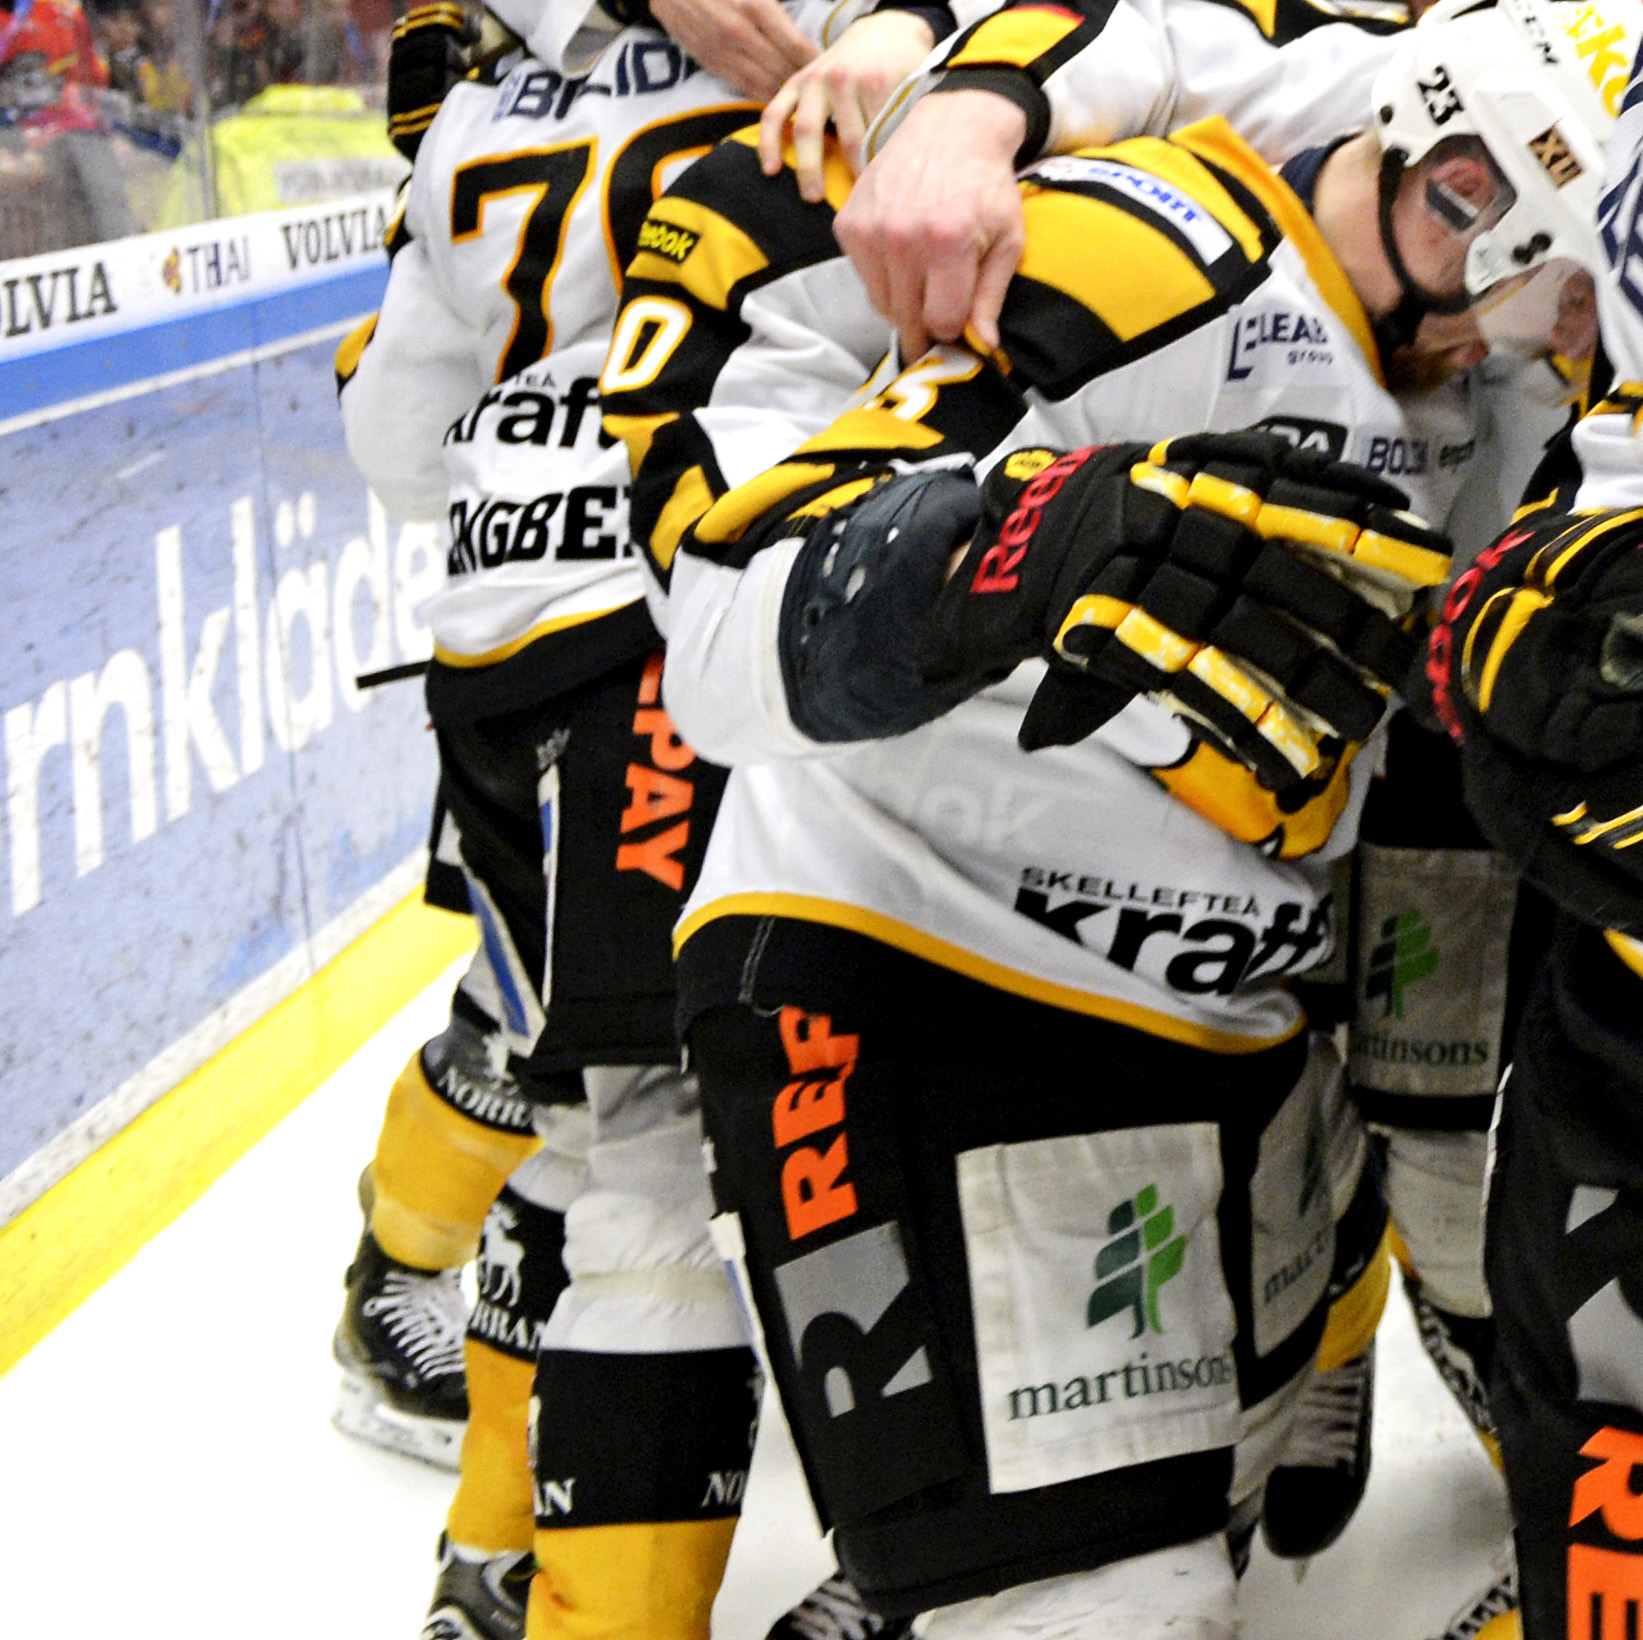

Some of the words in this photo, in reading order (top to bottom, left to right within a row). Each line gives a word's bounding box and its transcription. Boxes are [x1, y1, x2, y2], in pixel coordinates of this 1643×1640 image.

[1417, 62, 1466, 127] 23
[185, 236, 251, 294] THAI
[281, 205, 392, 272] VOLVIA
[1007, 1352, 1236, 1424] martinsons
